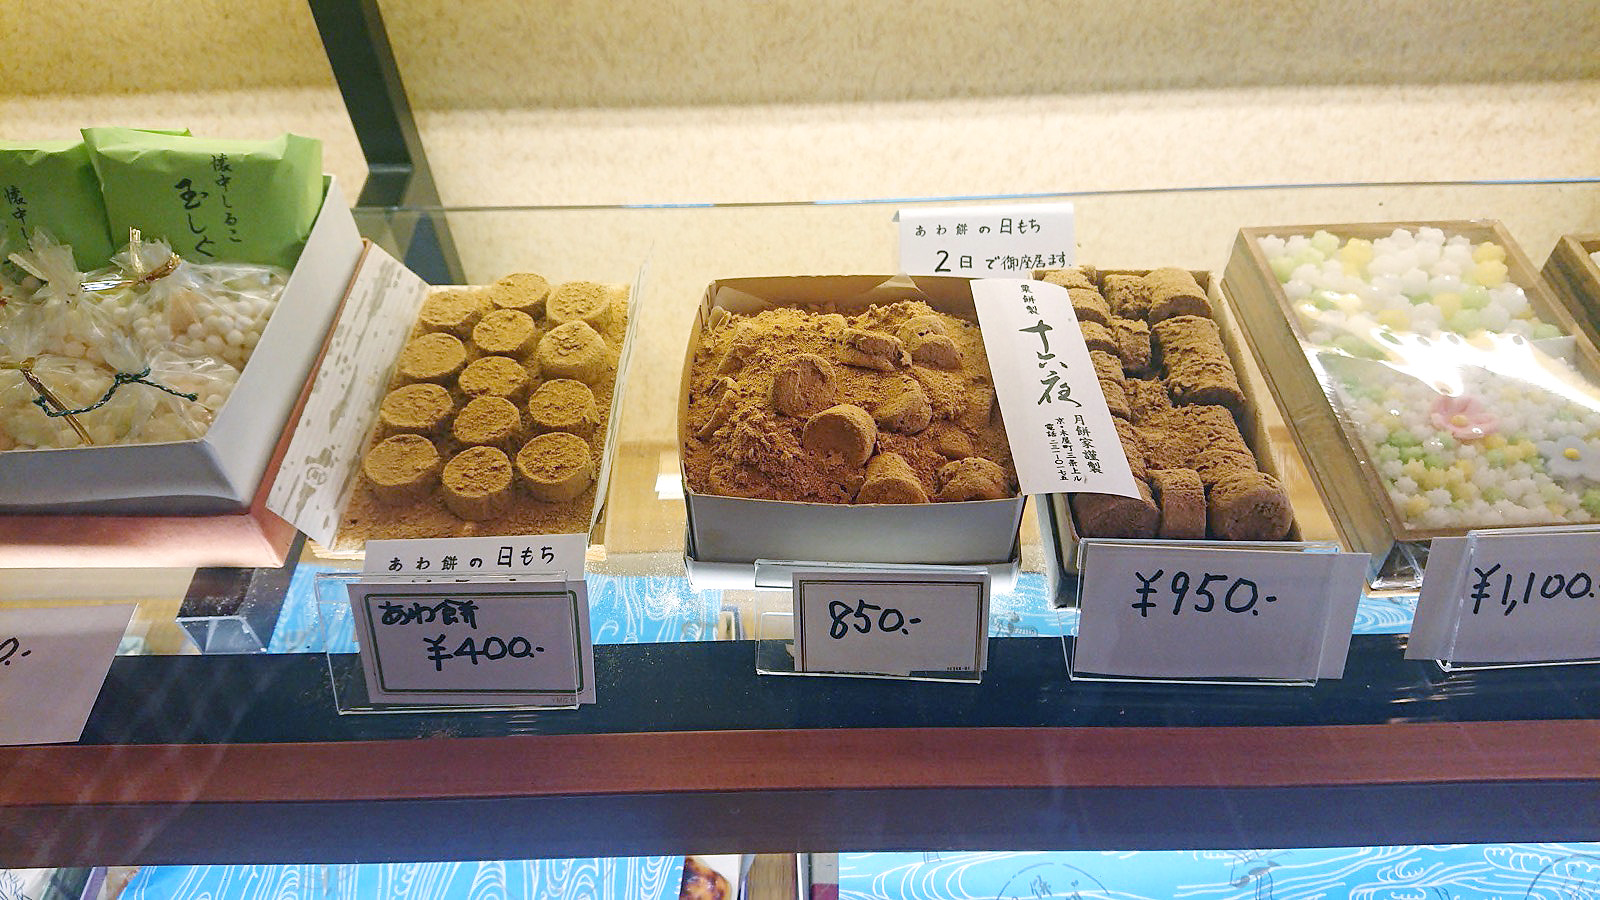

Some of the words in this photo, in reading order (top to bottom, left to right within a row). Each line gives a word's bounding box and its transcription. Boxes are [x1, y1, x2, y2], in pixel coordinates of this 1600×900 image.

[915, 218, 1041, 237] あわ餅の日もち
[1019, 319, 1082, 407] 十六夜
[389, 546, 554, 572] あわ餅の日もち
[378, 598, 479, 630] あわ餅
